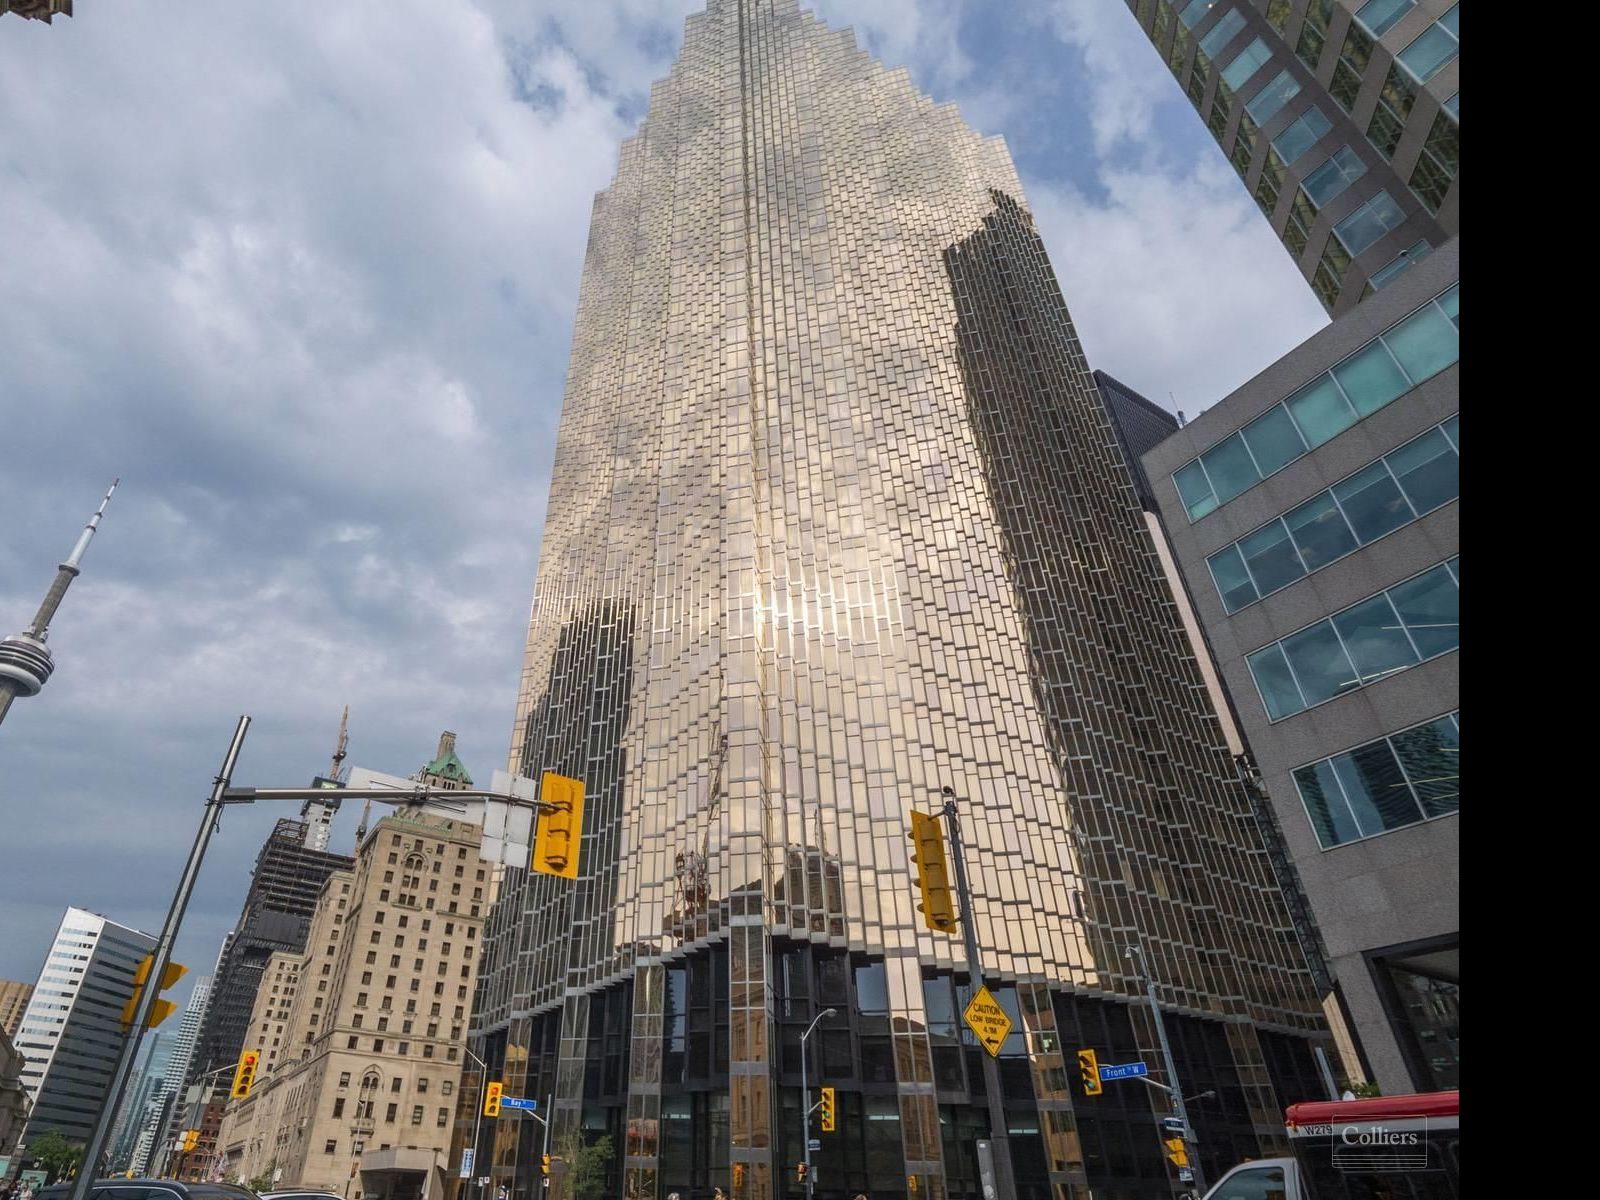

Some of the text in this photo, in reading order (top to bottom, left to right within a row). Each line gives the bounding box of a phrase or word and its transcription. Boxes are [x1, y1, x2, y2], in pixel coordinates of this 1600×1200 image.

[973, 1003, 1001, 1016] CAUTION
[970, 1014, 1007, 1026] LOW BRIDGE
[1106, 1067, 1126, 1077] Front
[1131, 1065, 1139, 1074] W
[511, 1099, 521, 1108] Bay
